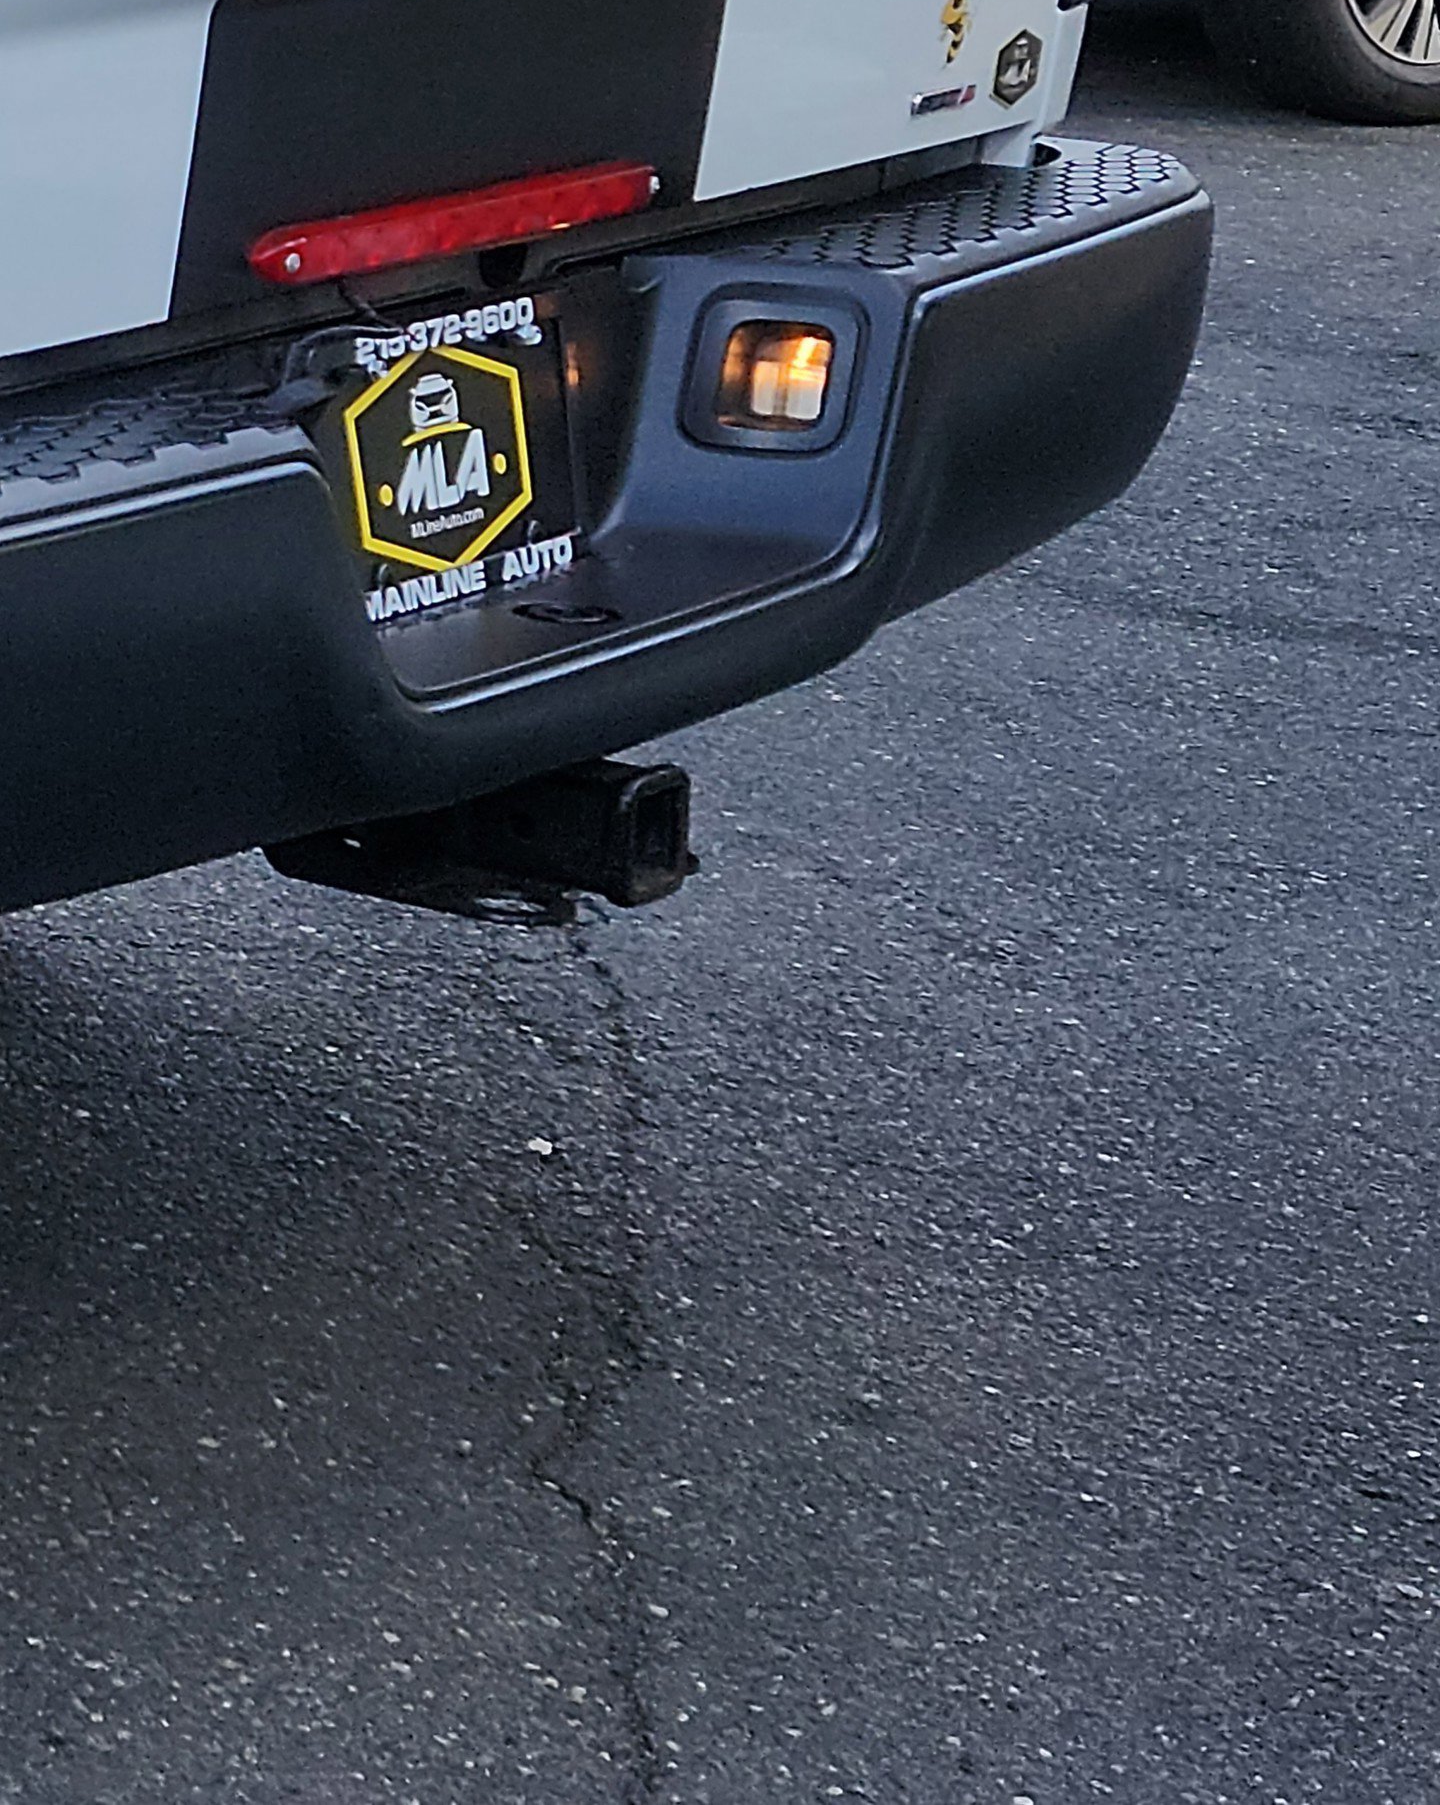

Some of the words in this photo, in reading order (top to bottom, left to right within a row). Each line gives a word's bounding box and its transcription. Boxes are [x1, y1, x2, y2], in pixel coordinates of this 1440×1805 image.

[397, 427, 490, 516] MLA
[365, 560, 487, 622] MAINLINE
[501, 535, 574, 581] AUTO
